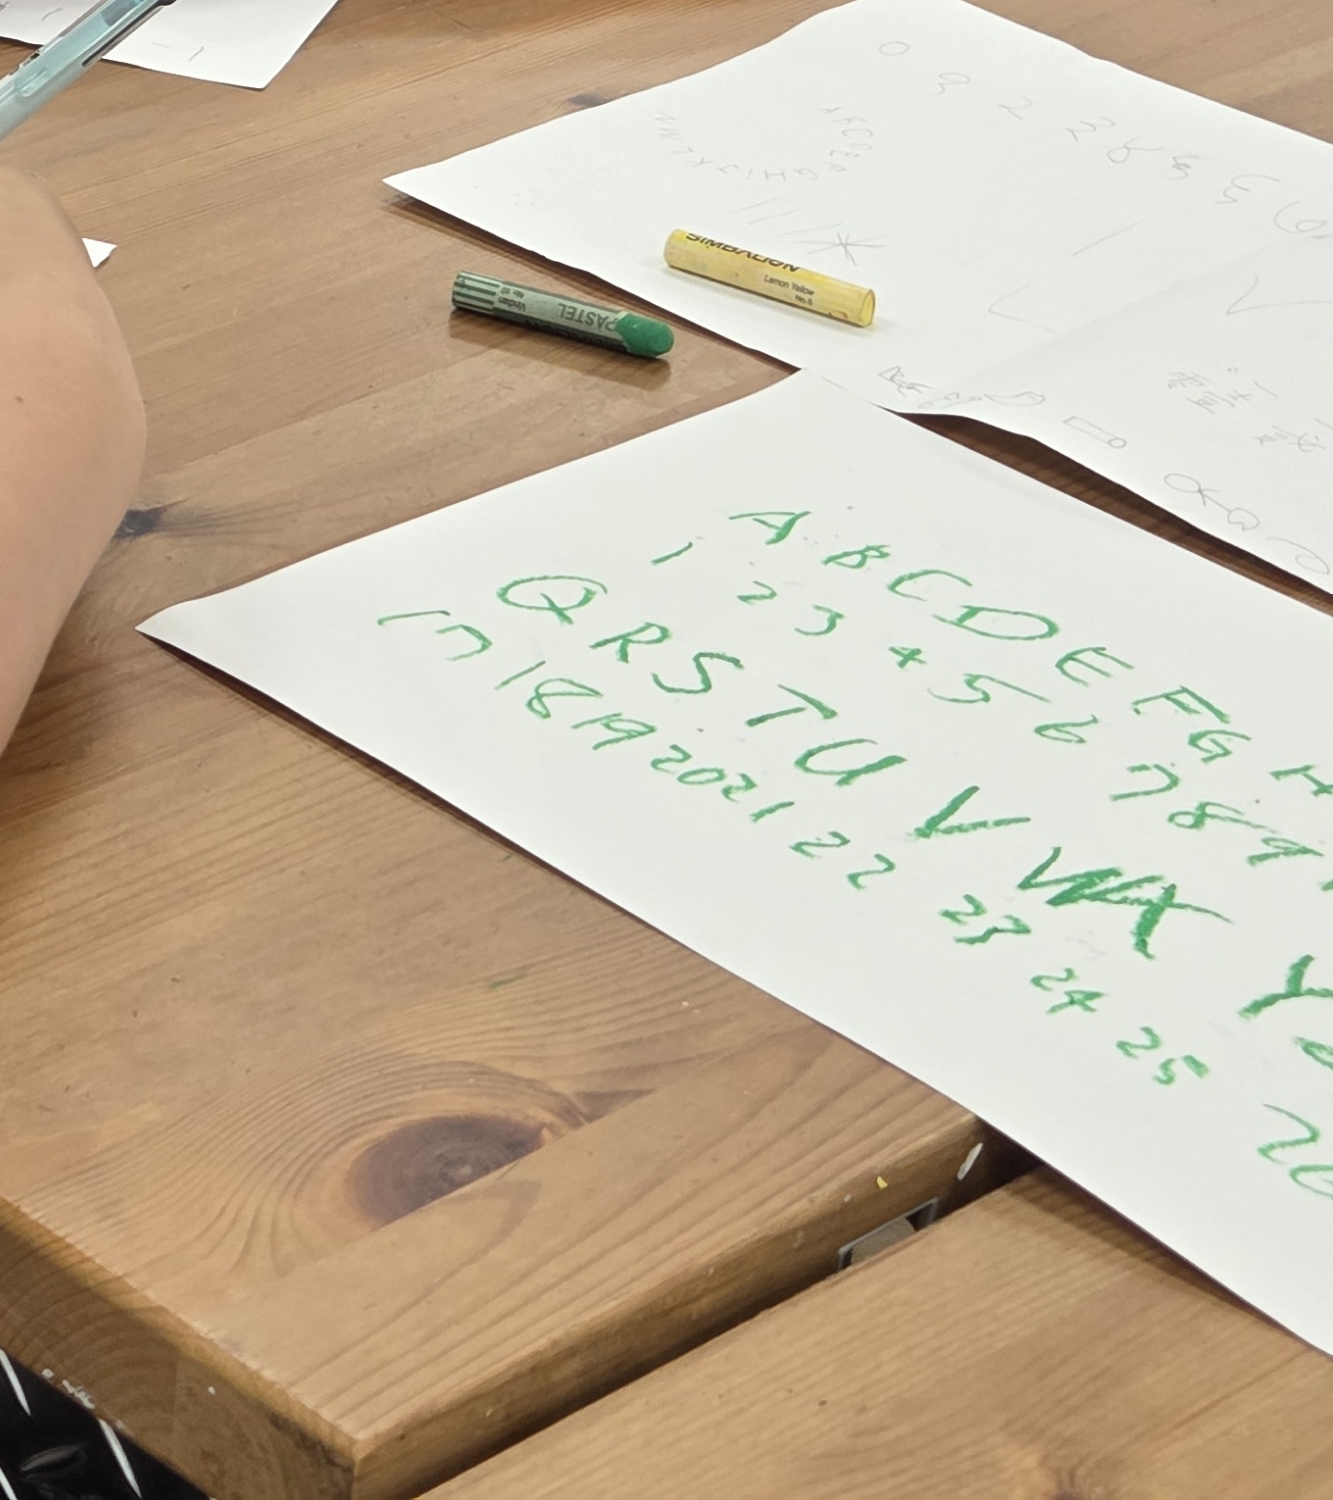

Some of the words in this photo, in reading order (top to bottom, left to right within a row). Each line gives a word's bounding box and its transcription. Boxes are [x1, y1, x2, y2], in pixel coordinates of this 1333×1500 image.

[557, 302, 618, 332] PASTEL
[764, 274, 790, 290] Lemon
[791, 281, 816, 297] Yellow
[496, 573, 609, 626] Q
[591, 620, 673, 665] R
[652, 650, 745, 696] S
[744, 683, 838, 729] T
[793, 737, 908, 788] U
[910, 784, 1032, 841] V
[729, 510, 810, 546] A
[821, 544, 891, 571] B
[887, 569, 973, 602] C
[933, 604, 1061, 642] D
[1055, 645, 1134, 685] E
[1131, 685, 1230, 724] F
[1187, 729, 1252, 764] G
[737, 580, 778, 605] 2
[794, 604, 845, 637] 3
[889, 645, 927, 670] 4
[1110, 762, 1182, 802] 7
